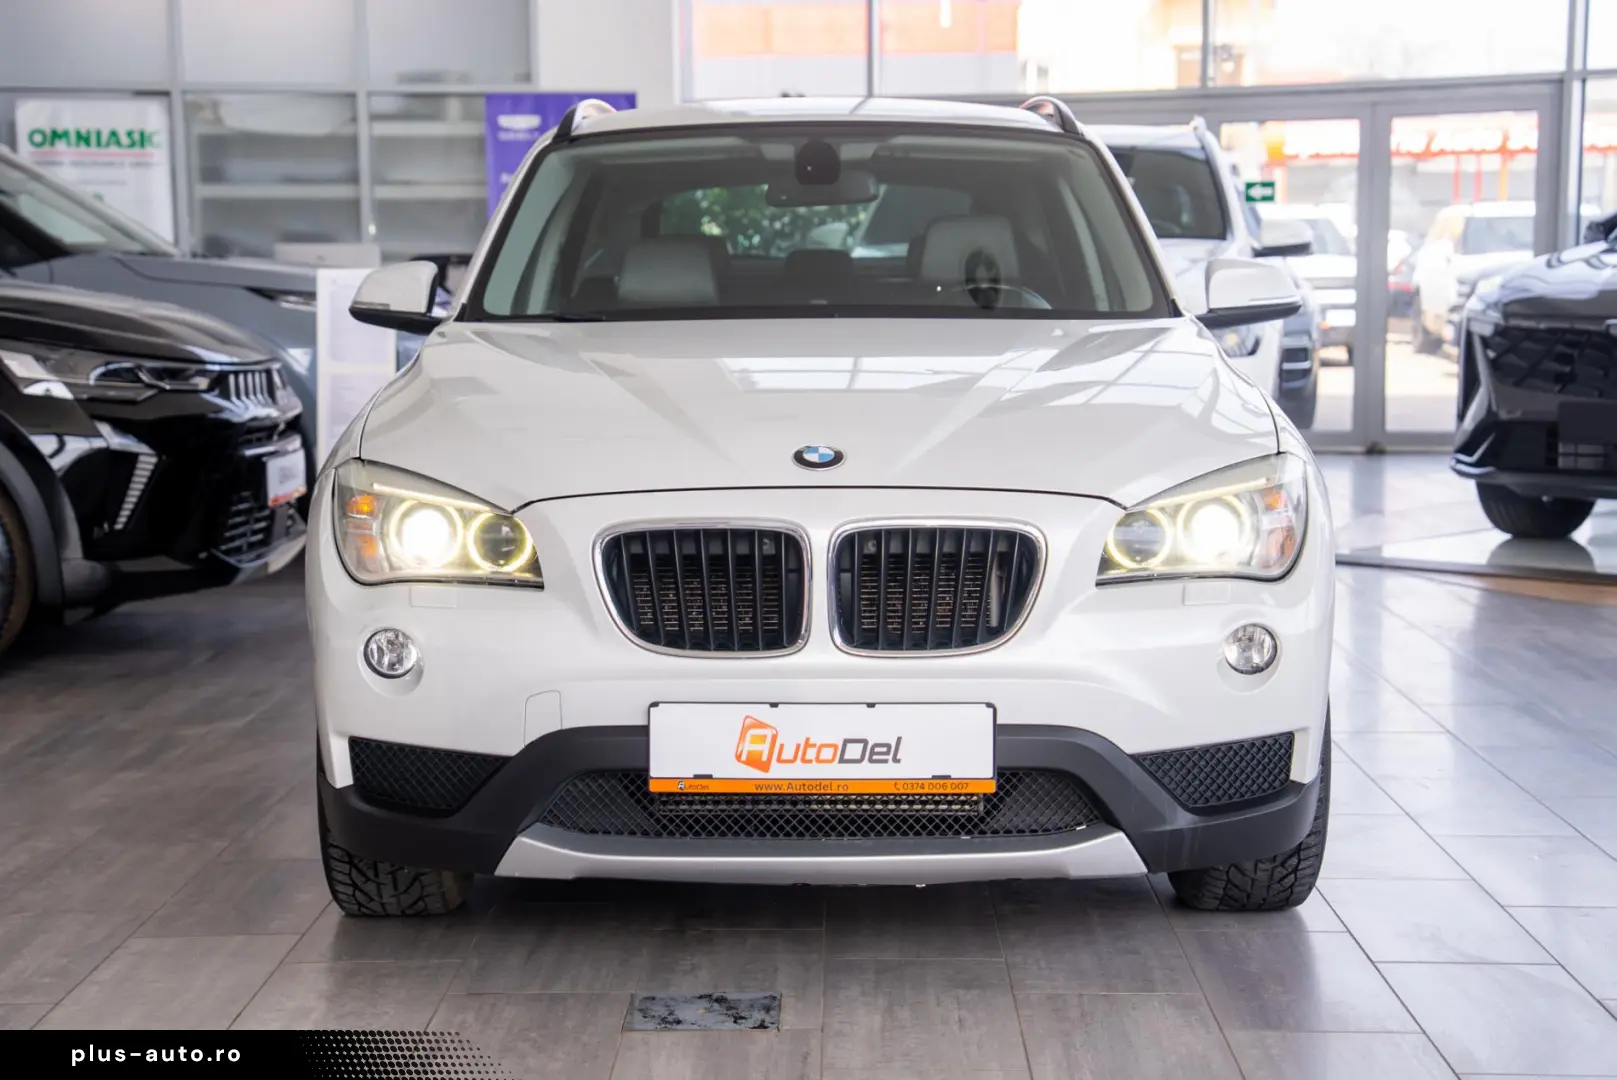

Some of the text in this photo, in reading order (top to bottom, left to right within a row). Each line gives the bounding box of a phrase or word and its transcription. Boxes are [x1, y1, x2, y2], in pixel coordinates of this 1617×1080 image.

[735, 715, 902, 773] AutoDel
[754, 782, 849, 793] www.Autodel.ro
[902, 782, 969, 791] 0374 006 007
